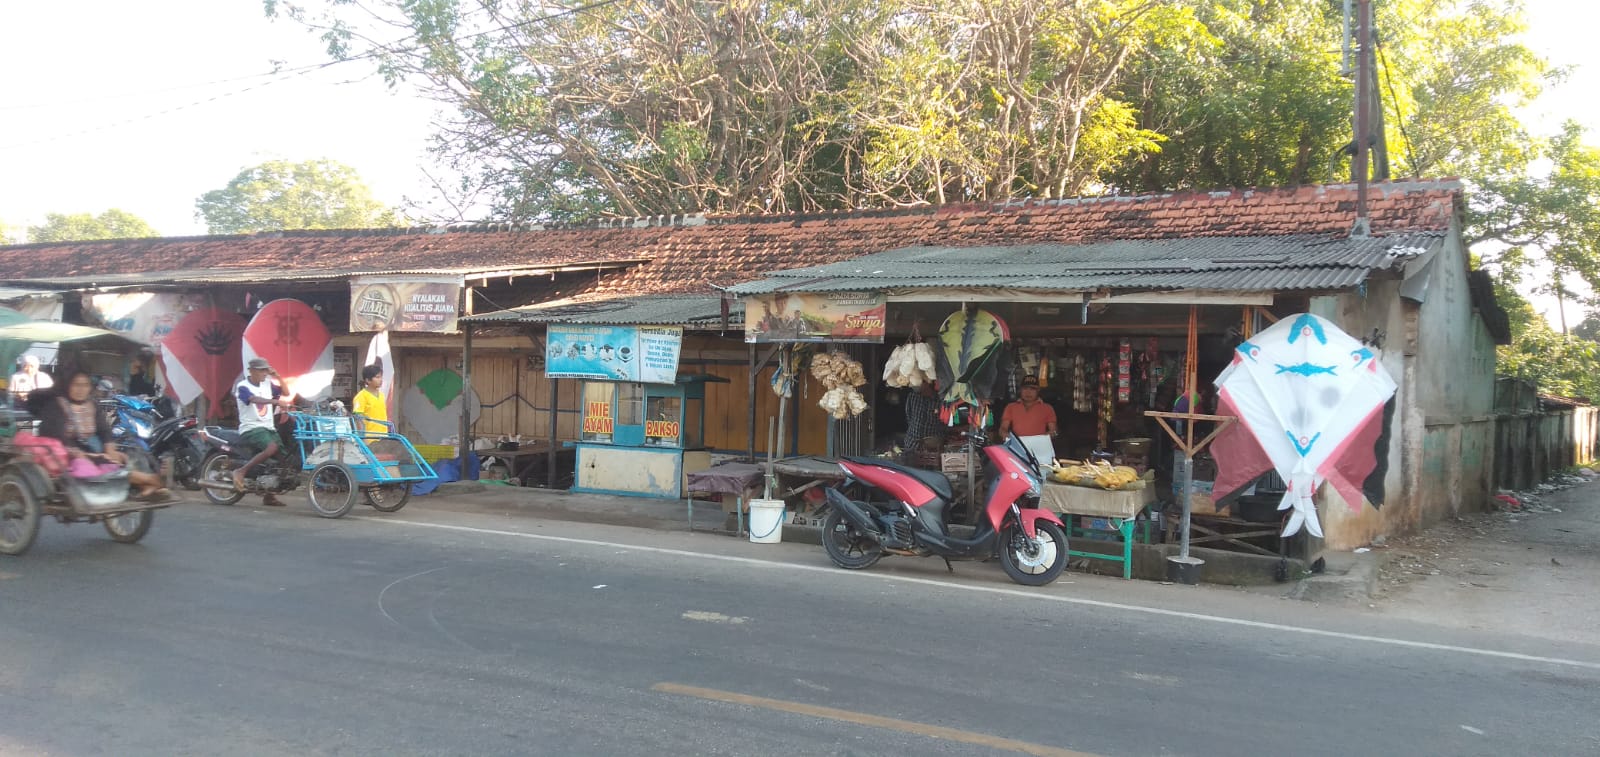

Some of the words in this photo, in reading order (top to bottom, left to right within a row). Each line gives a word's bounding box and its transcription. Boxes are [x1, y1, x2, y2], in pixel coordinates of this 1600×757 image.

[412, 294, 446, 303] NYALAKAN
[359, 300, 388, 315] JUARA
[434, 304, 455, 313] JUARA
[845, 315, 884, 334] Surya
[589, 402, 609, 417] MIE
[584, 418, 613, 433] AYAM
[645, 420, 680, 437] BAKSO
